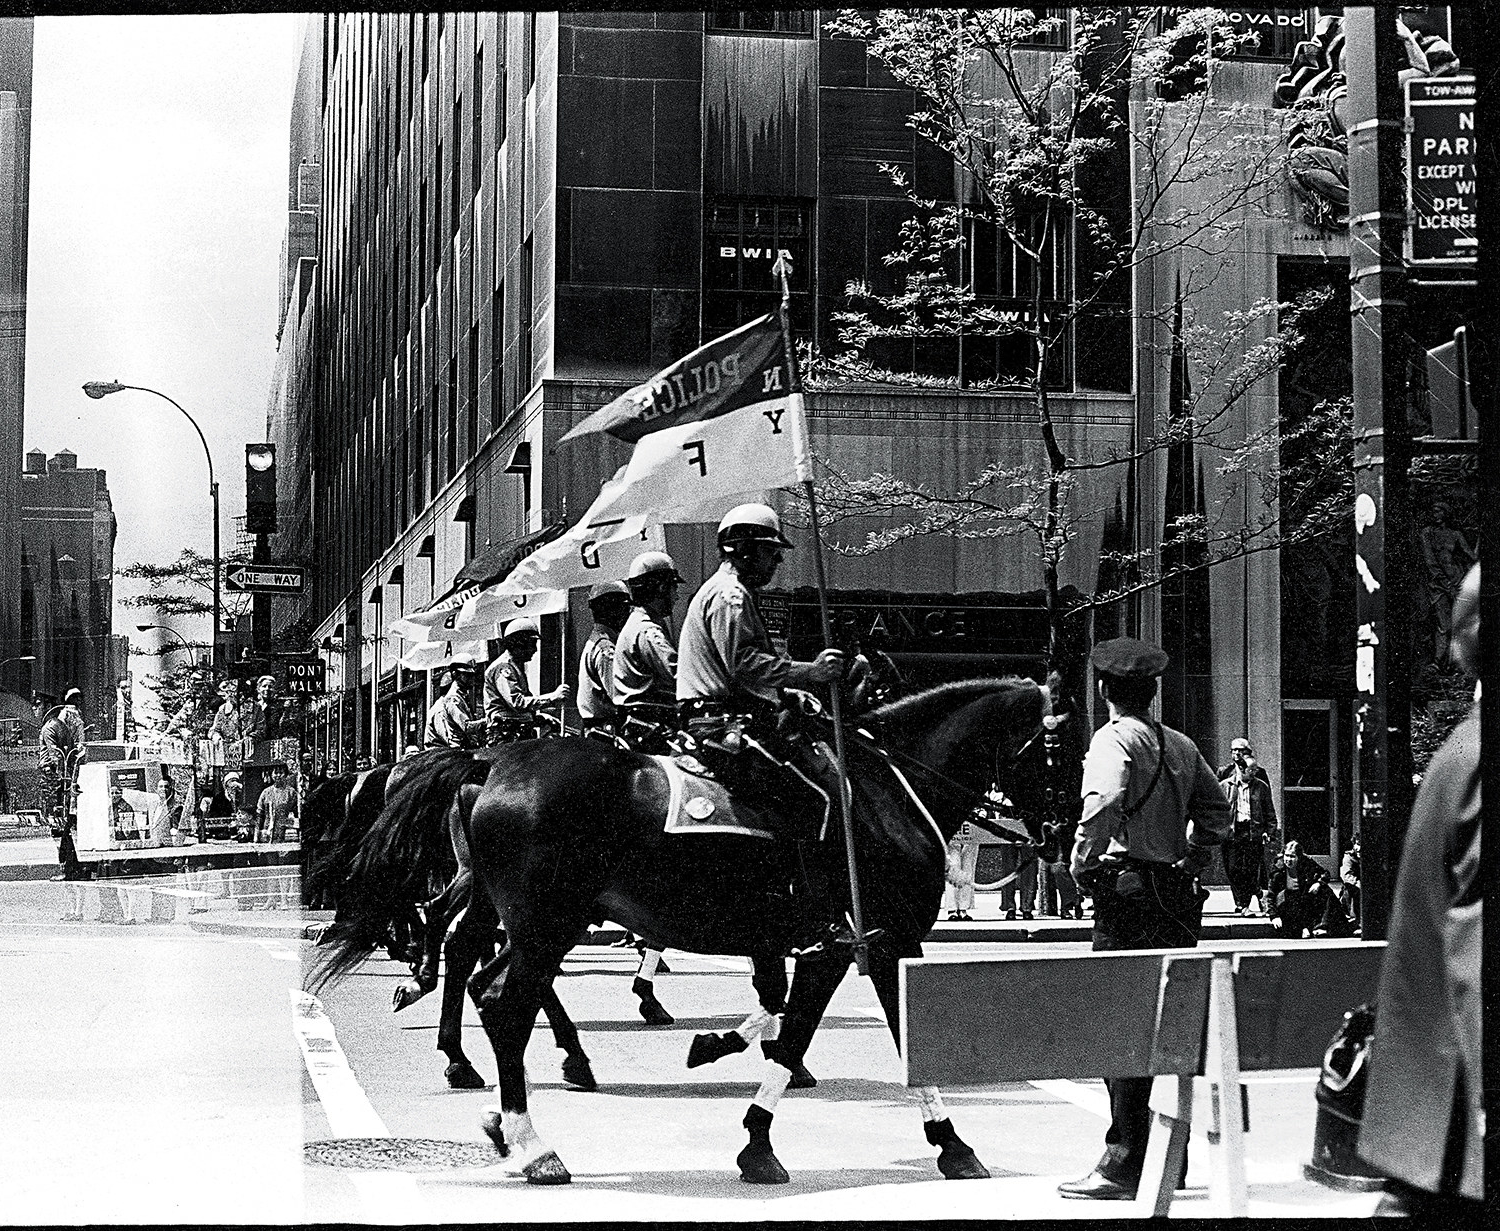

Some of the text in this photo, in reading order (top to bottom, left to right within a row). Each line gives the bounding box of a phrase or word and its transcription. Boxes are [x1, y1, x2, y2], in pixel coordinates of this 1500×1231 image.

[1424, 137, 1476, 155] PAR
[1418, 164, 1465, 179] EXCEPT
[1433, 197, 1468, 211] DPL
[720, 246, 793, 260] BWIA
[999, 311, 1050, 323] WIA
[237, 573, 297, 585] ONE WAY
[288, 681, 322, 692] WALK
